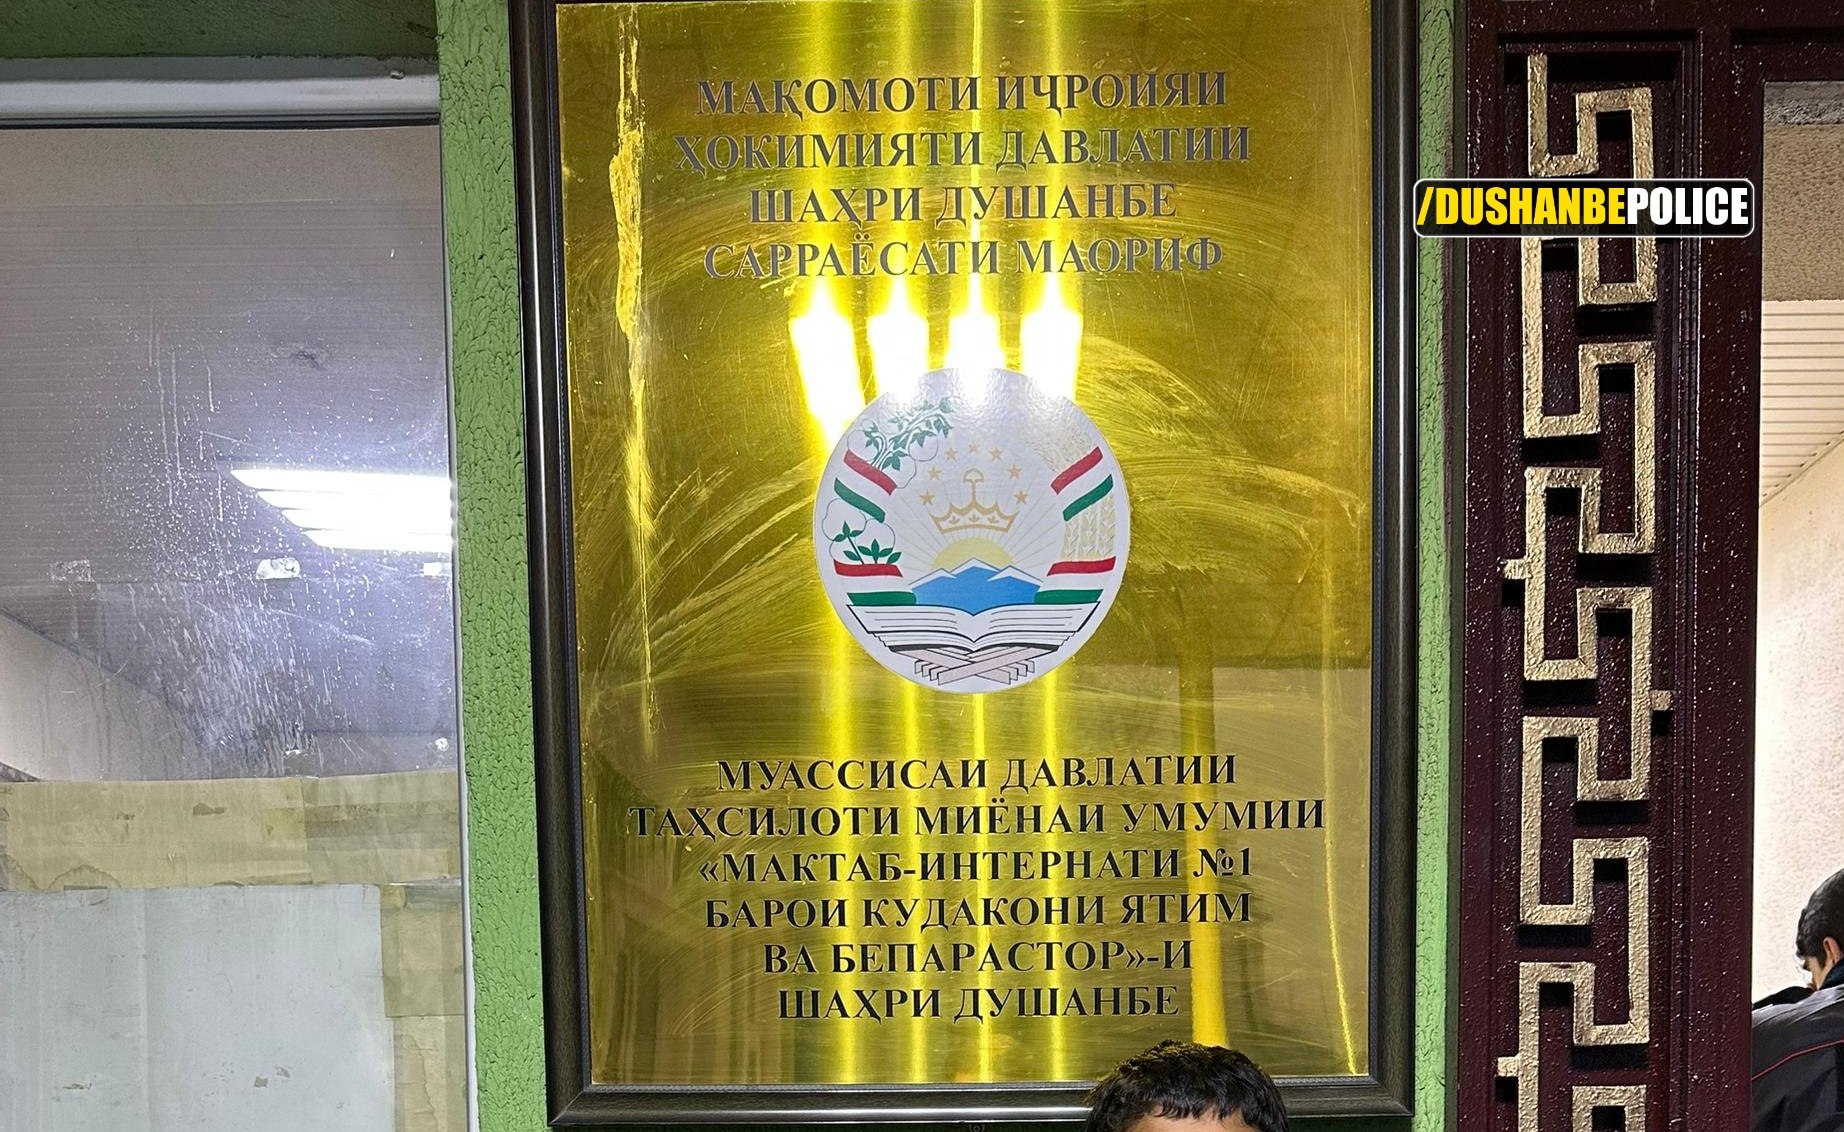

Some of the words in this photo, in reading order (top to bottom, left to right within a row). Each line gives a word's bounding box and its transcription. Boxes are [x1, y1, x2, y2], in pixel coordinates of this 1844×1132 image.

[697, 76, 982, 120] МАҚОМОТИ
[996, 71, 1227, 117] ИҶРОИЯИ
[675, 129, 984, 175] ҲОКИМИЯТИ
[995, 126, 1250, 170] ДАВЛАТИИ
[750, 185, 922, 228] ШАҲРИ
[936, 182, 1178, 226] ДУШАНБЕ
[703, 232, 1001, 279] САРРАЁСАТИ
[1015, 236, 1223, 274] МАОРИФ
[717, 758, 988, 791] МУАССИСАИ
[1000, 754, 1237, 793] ДАВЛАТИИ
[629, 804, 900, 840] ТАҲСИЛОТИ
[915, 797, 1105, 836] МИЁНАИ
[1123, 800, 1325, 834] УМУМИИ
[700, 850, 1182, 884] «МАКТАБ-ИНТЕРНАТИ
[1192, 847, 1252, 878] №1
[705, 899, 849, 930] БАРОИ
[862, 895, 1105, 932] КУДАКОНИ
[1120, 892, 1252, 924] ЯТИМ
[763, 943, 818, 975] ВА
[831, 938, 1194, 974] БЕПАРАСТОР»-И
[777, 988, 942, 1024] ШАҲРИ
[954, 985, 1180, 1023] ДУШАНБЕ
